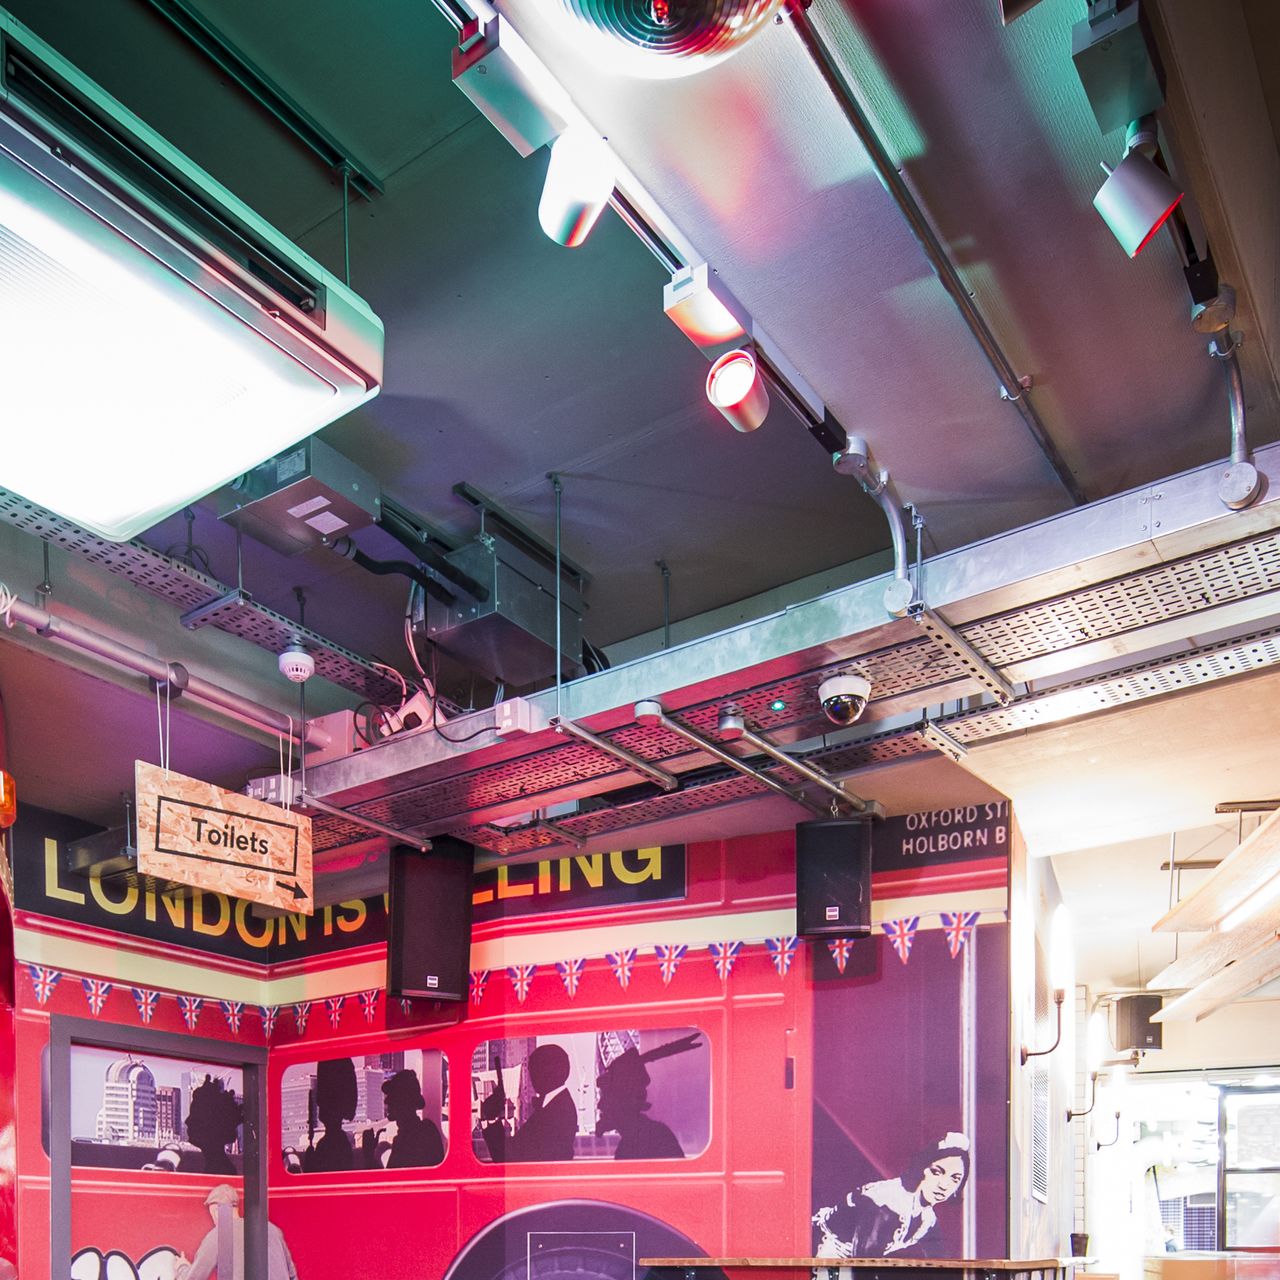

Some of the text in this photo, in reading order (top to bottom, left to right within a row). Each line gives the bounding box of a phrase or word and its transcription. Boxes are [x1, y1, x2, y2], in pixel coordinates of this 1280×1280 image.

[906, 805, 978, 831] OXFORD
[191, 817, 269, 855] Toilets
[902, 828, 988, 855] HOLBORN
